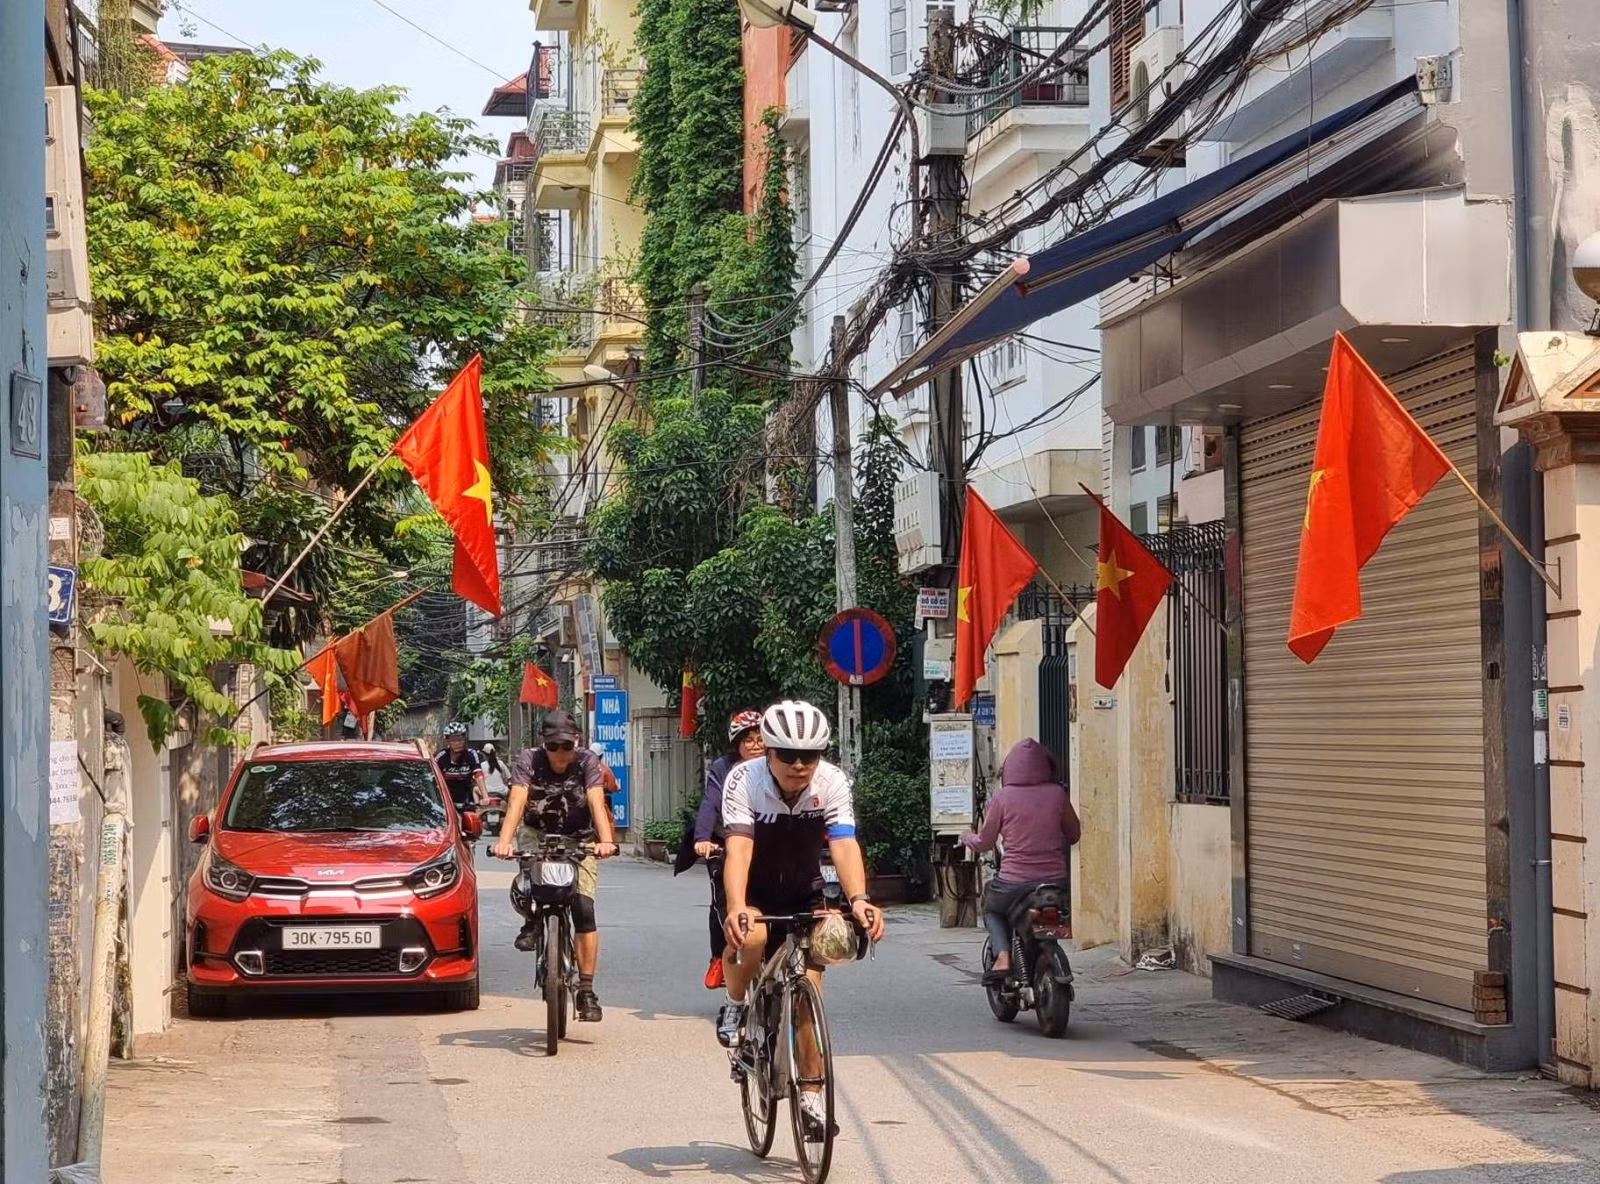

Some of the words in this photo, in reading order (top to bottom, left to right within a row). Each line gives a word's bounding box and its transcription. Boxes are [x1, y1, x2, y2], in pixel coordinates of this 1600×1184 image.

[602, 695, 620, 714] NHÀ
[597, 719, 626, 741] THUỐC
[724, 764, 750, 801] TIGER
[291, 931, 372, 945] 30K-795.60
